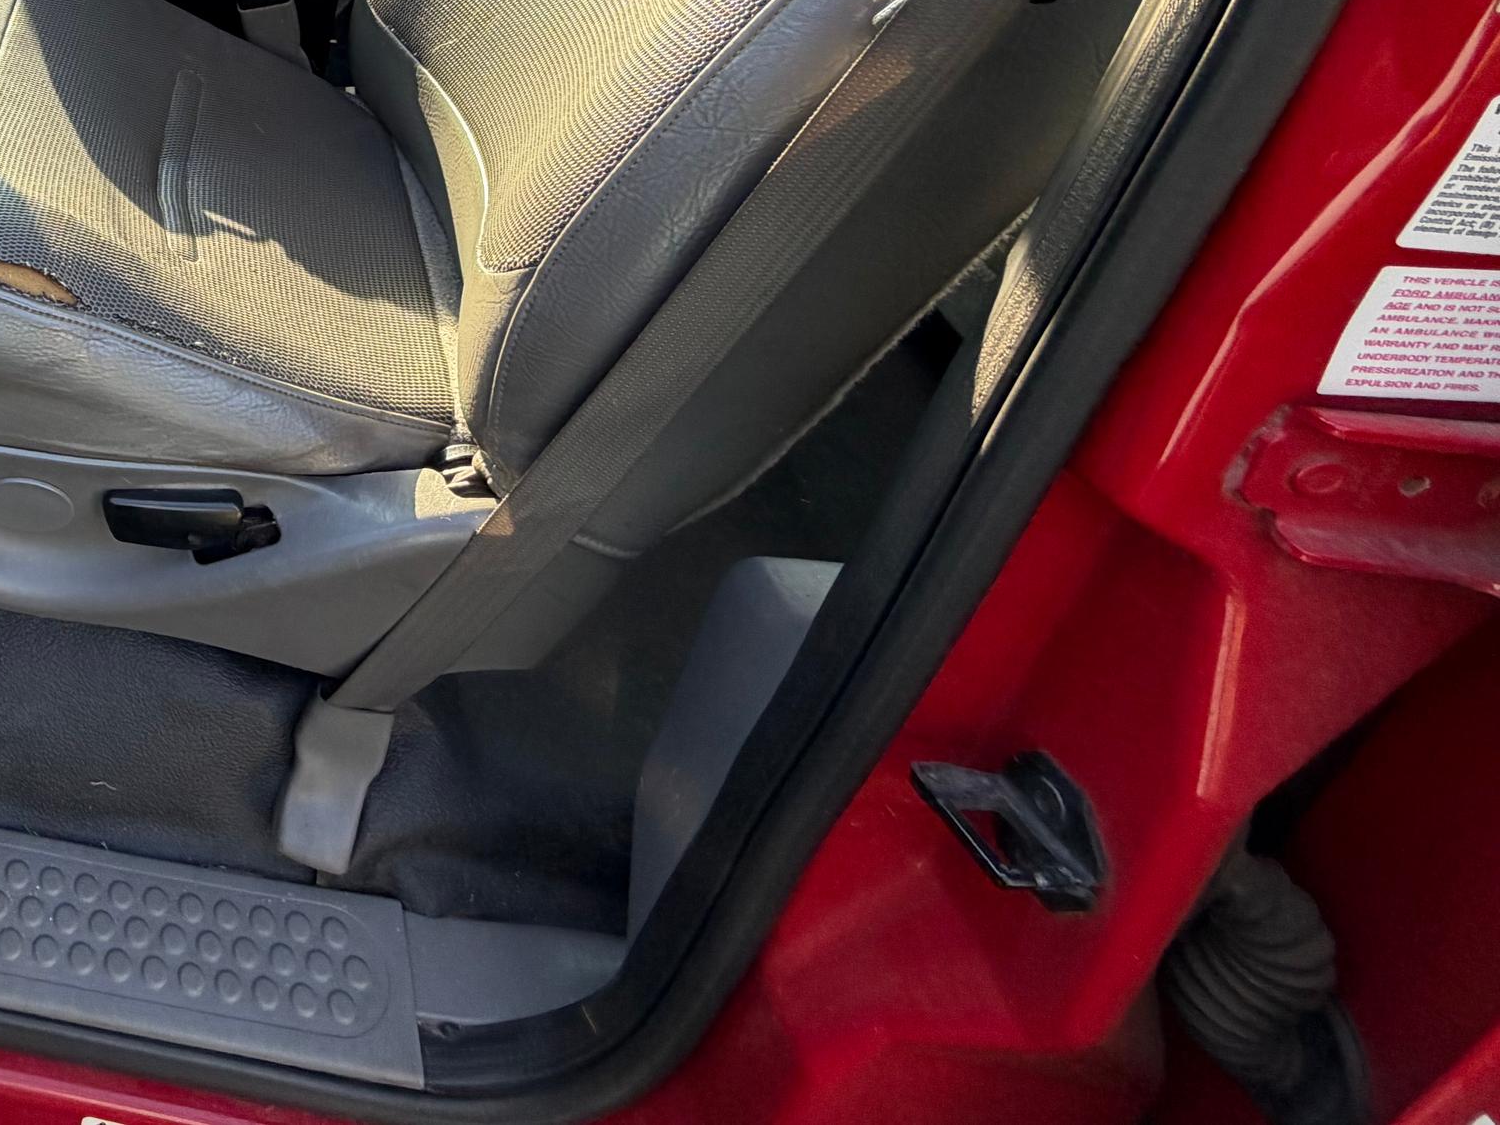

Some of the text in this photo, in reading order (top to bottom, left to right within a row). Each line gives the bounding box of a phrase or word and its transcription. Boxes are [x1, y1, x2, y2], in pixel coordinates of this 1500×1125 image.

[1402, 275, 1432, 285] THIS
[1434, 277, 1488, 287] VEHICLE
[1391, 288, 1431, 298] FORD
[1383, 301, 1412, 311] AGE
[1413, 303, 1442, 312] AND
[1443, 304, 1457, 312] IS
[1458, 305, 1486, 313] NOT
[1369, 326, 1390, 335] AN
[1393, 327, 1479, 338] AMBULANCE
[1364, 339, 1431, 349] WARRANTY
[1432, 342, 1460, 351] AND
[1461, 343, 1489, 352] MAY
[1357, 352, 1432, 363] UNDERBODY
[1350, 365, 1456, 378] PRESSURIZATION
[1457, 370, 1485, 379] AND
[1345, 378, 1413, 389] EXPULSION
[1414, 381, 1442, 390] AND
